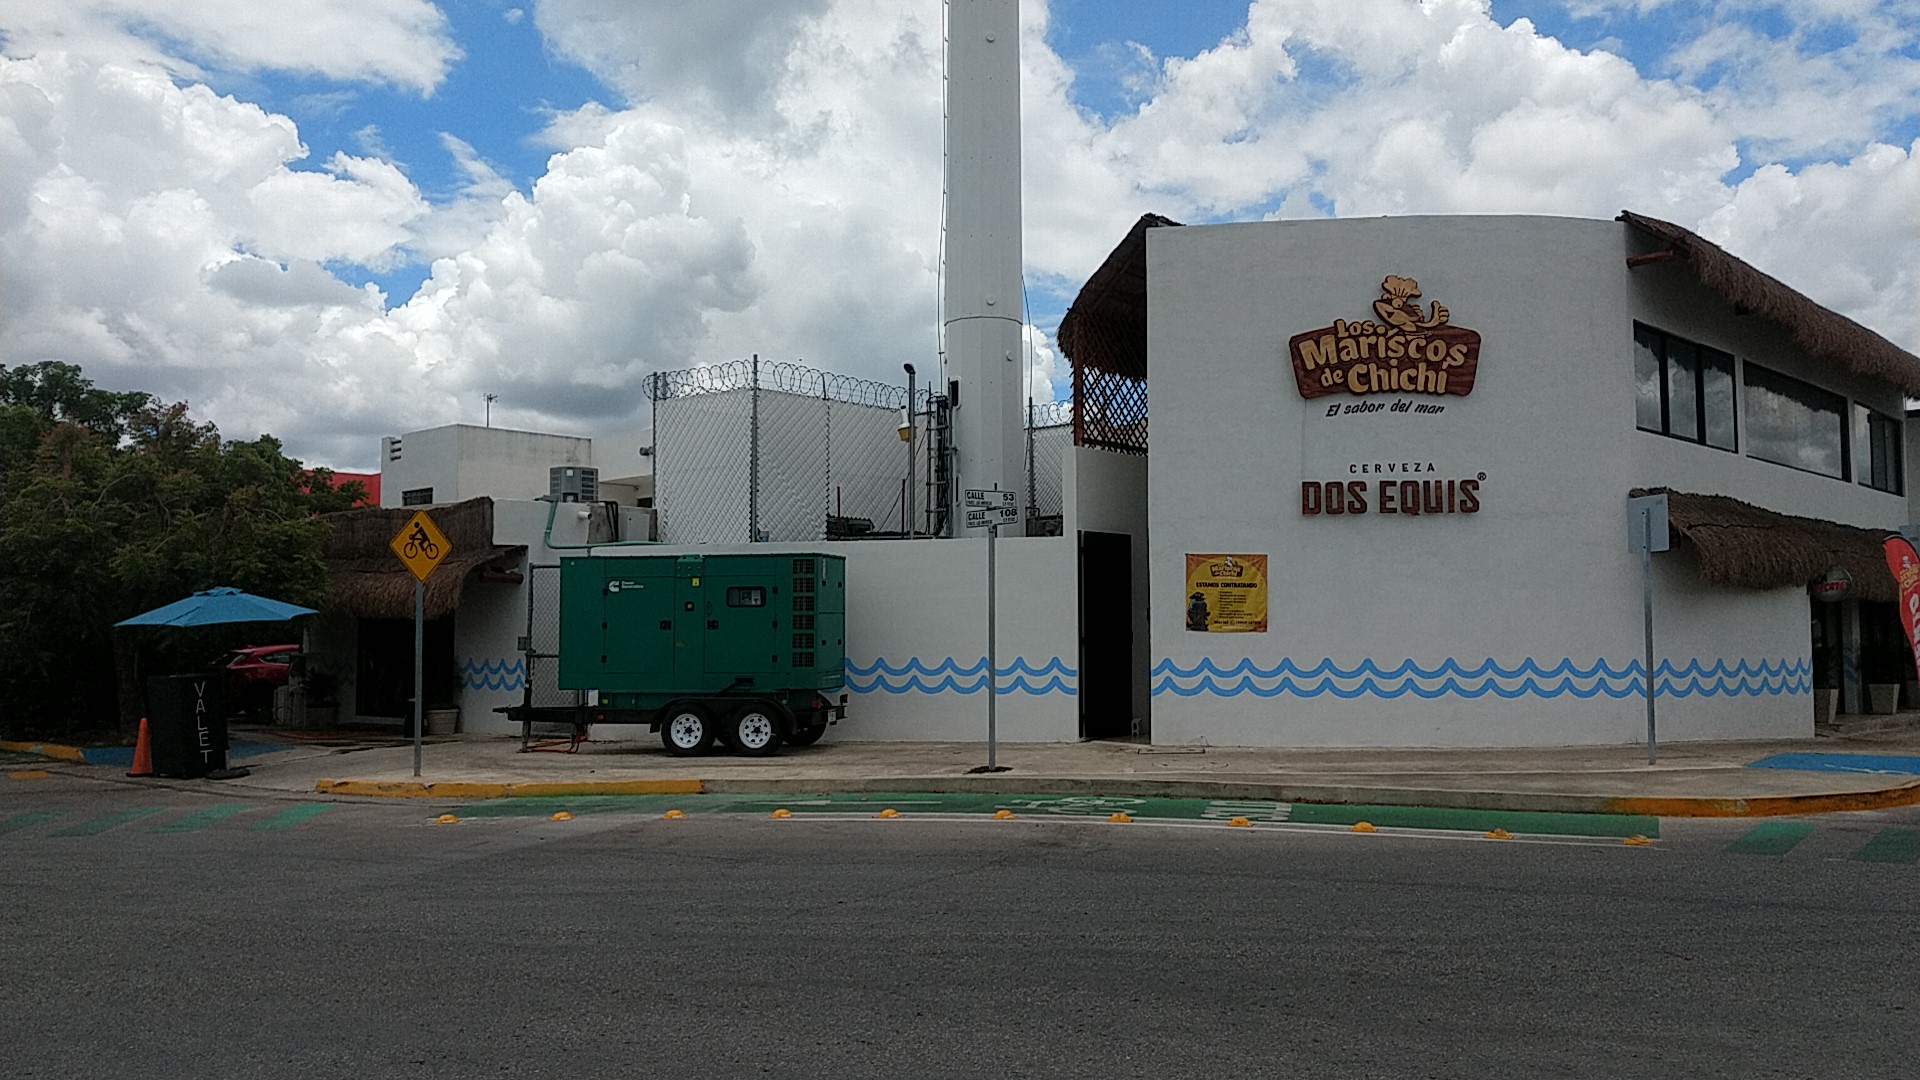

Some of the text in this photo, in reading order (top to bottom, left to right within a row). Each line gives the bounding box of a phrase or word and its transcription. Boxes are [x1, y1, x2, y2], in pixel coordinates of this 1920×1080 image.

[1336, 319, 1374, 338] Los
[1298, 328, 1468, 371] Mariscos
[1320, 367, 1344, 387] de
[1325, 399, 1446, 417] El sabor del mar
[1349, 462, 1435, 474] CERVEZA
[966, 492, 1014, 501] CALLE 53
[1302, 481, 1368, 515] DOS
[968, 508, 1017, 521] CALLE 108
[194, 681, 213, 764] VALET
